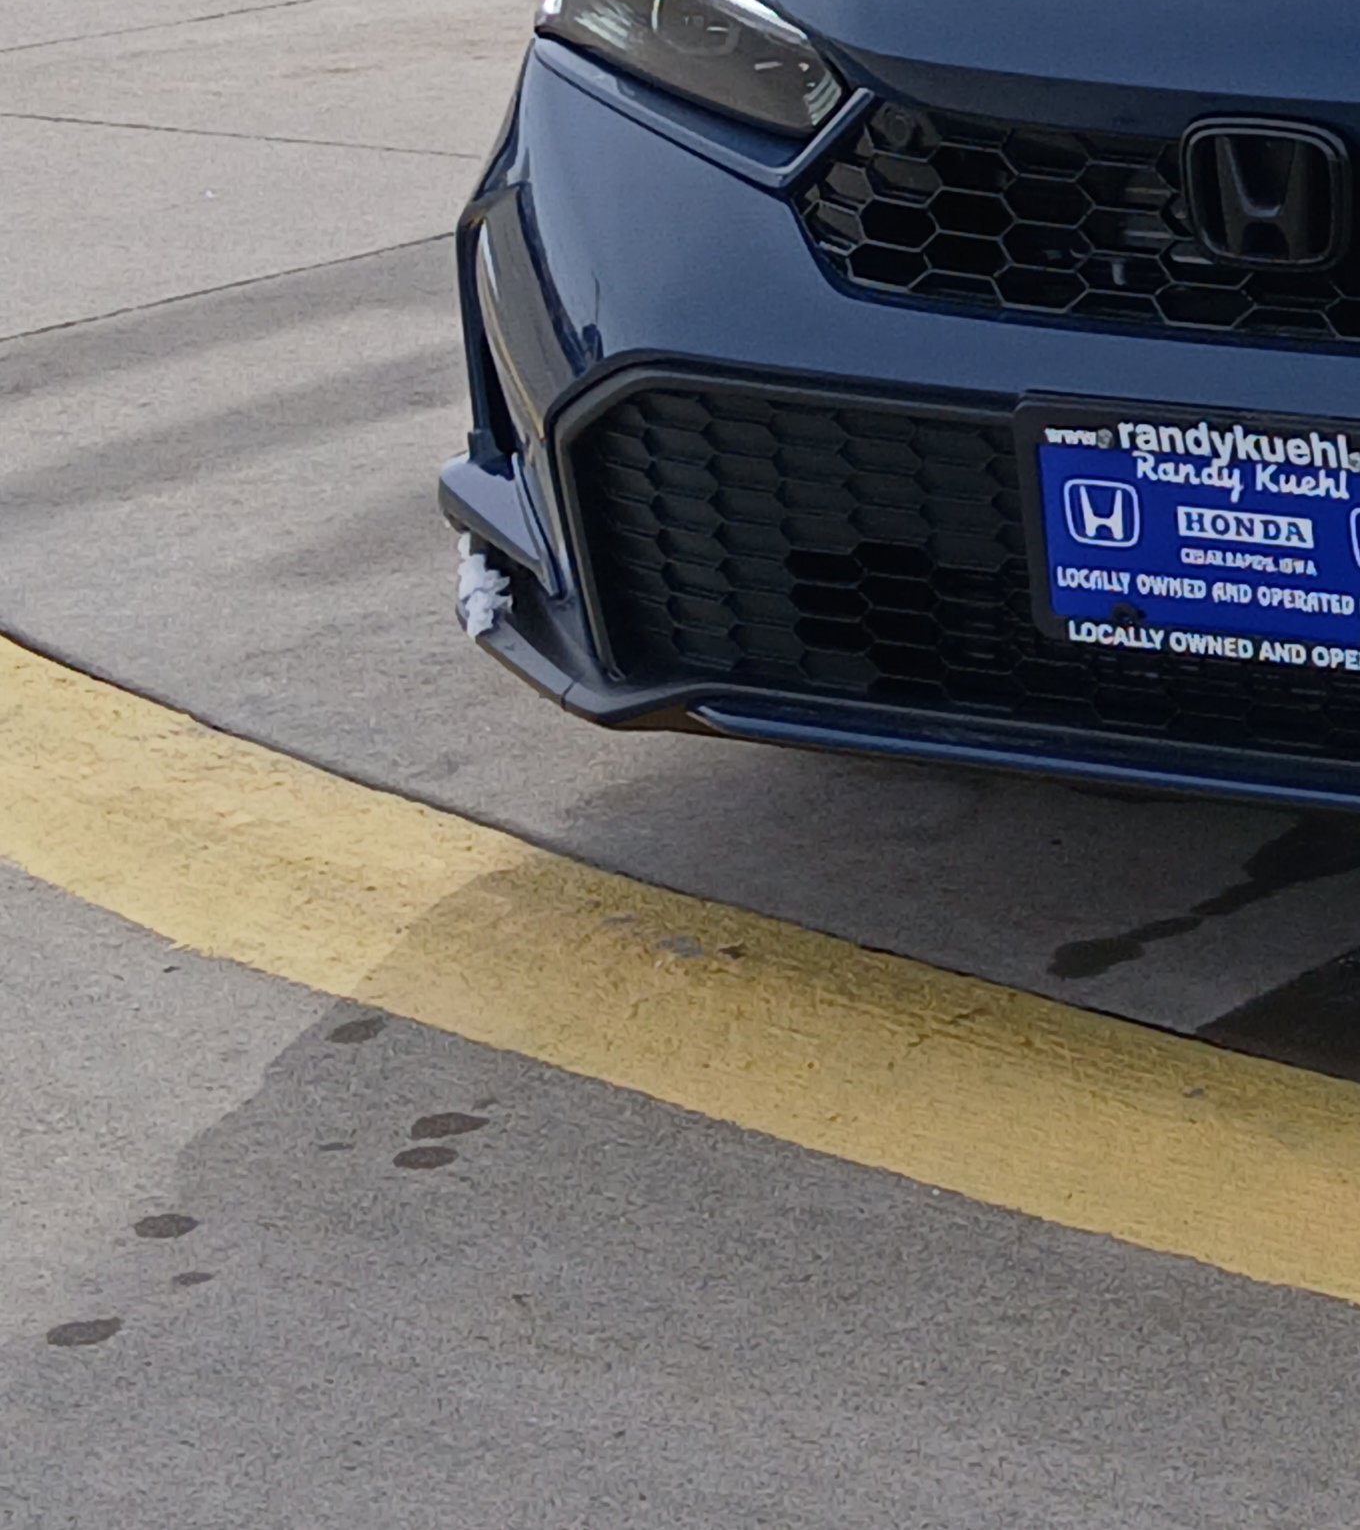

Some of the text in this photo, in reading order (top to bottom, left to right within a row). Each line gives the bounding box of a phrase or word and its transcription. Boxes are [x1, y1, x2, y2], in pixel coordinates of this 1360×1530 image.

[1117, 421, 1350, 469] randykuehl
[1132, 450, 1350, 504] Randy Kuehl
[1183, 510, 1307, 544] HONDA
[1056, 566, 1131, 595] LOCALLY
[1136, 574, 1207, 599] OWNED
[1212, 582, 1253, 604] AND
[1257, 586, 1355, 616] OPERATED
[1068, 620, 1165, 650] LOCALLY
[1169, 631, 1254, 659] OWNED
[1258, 640, 1307, 665] AND
